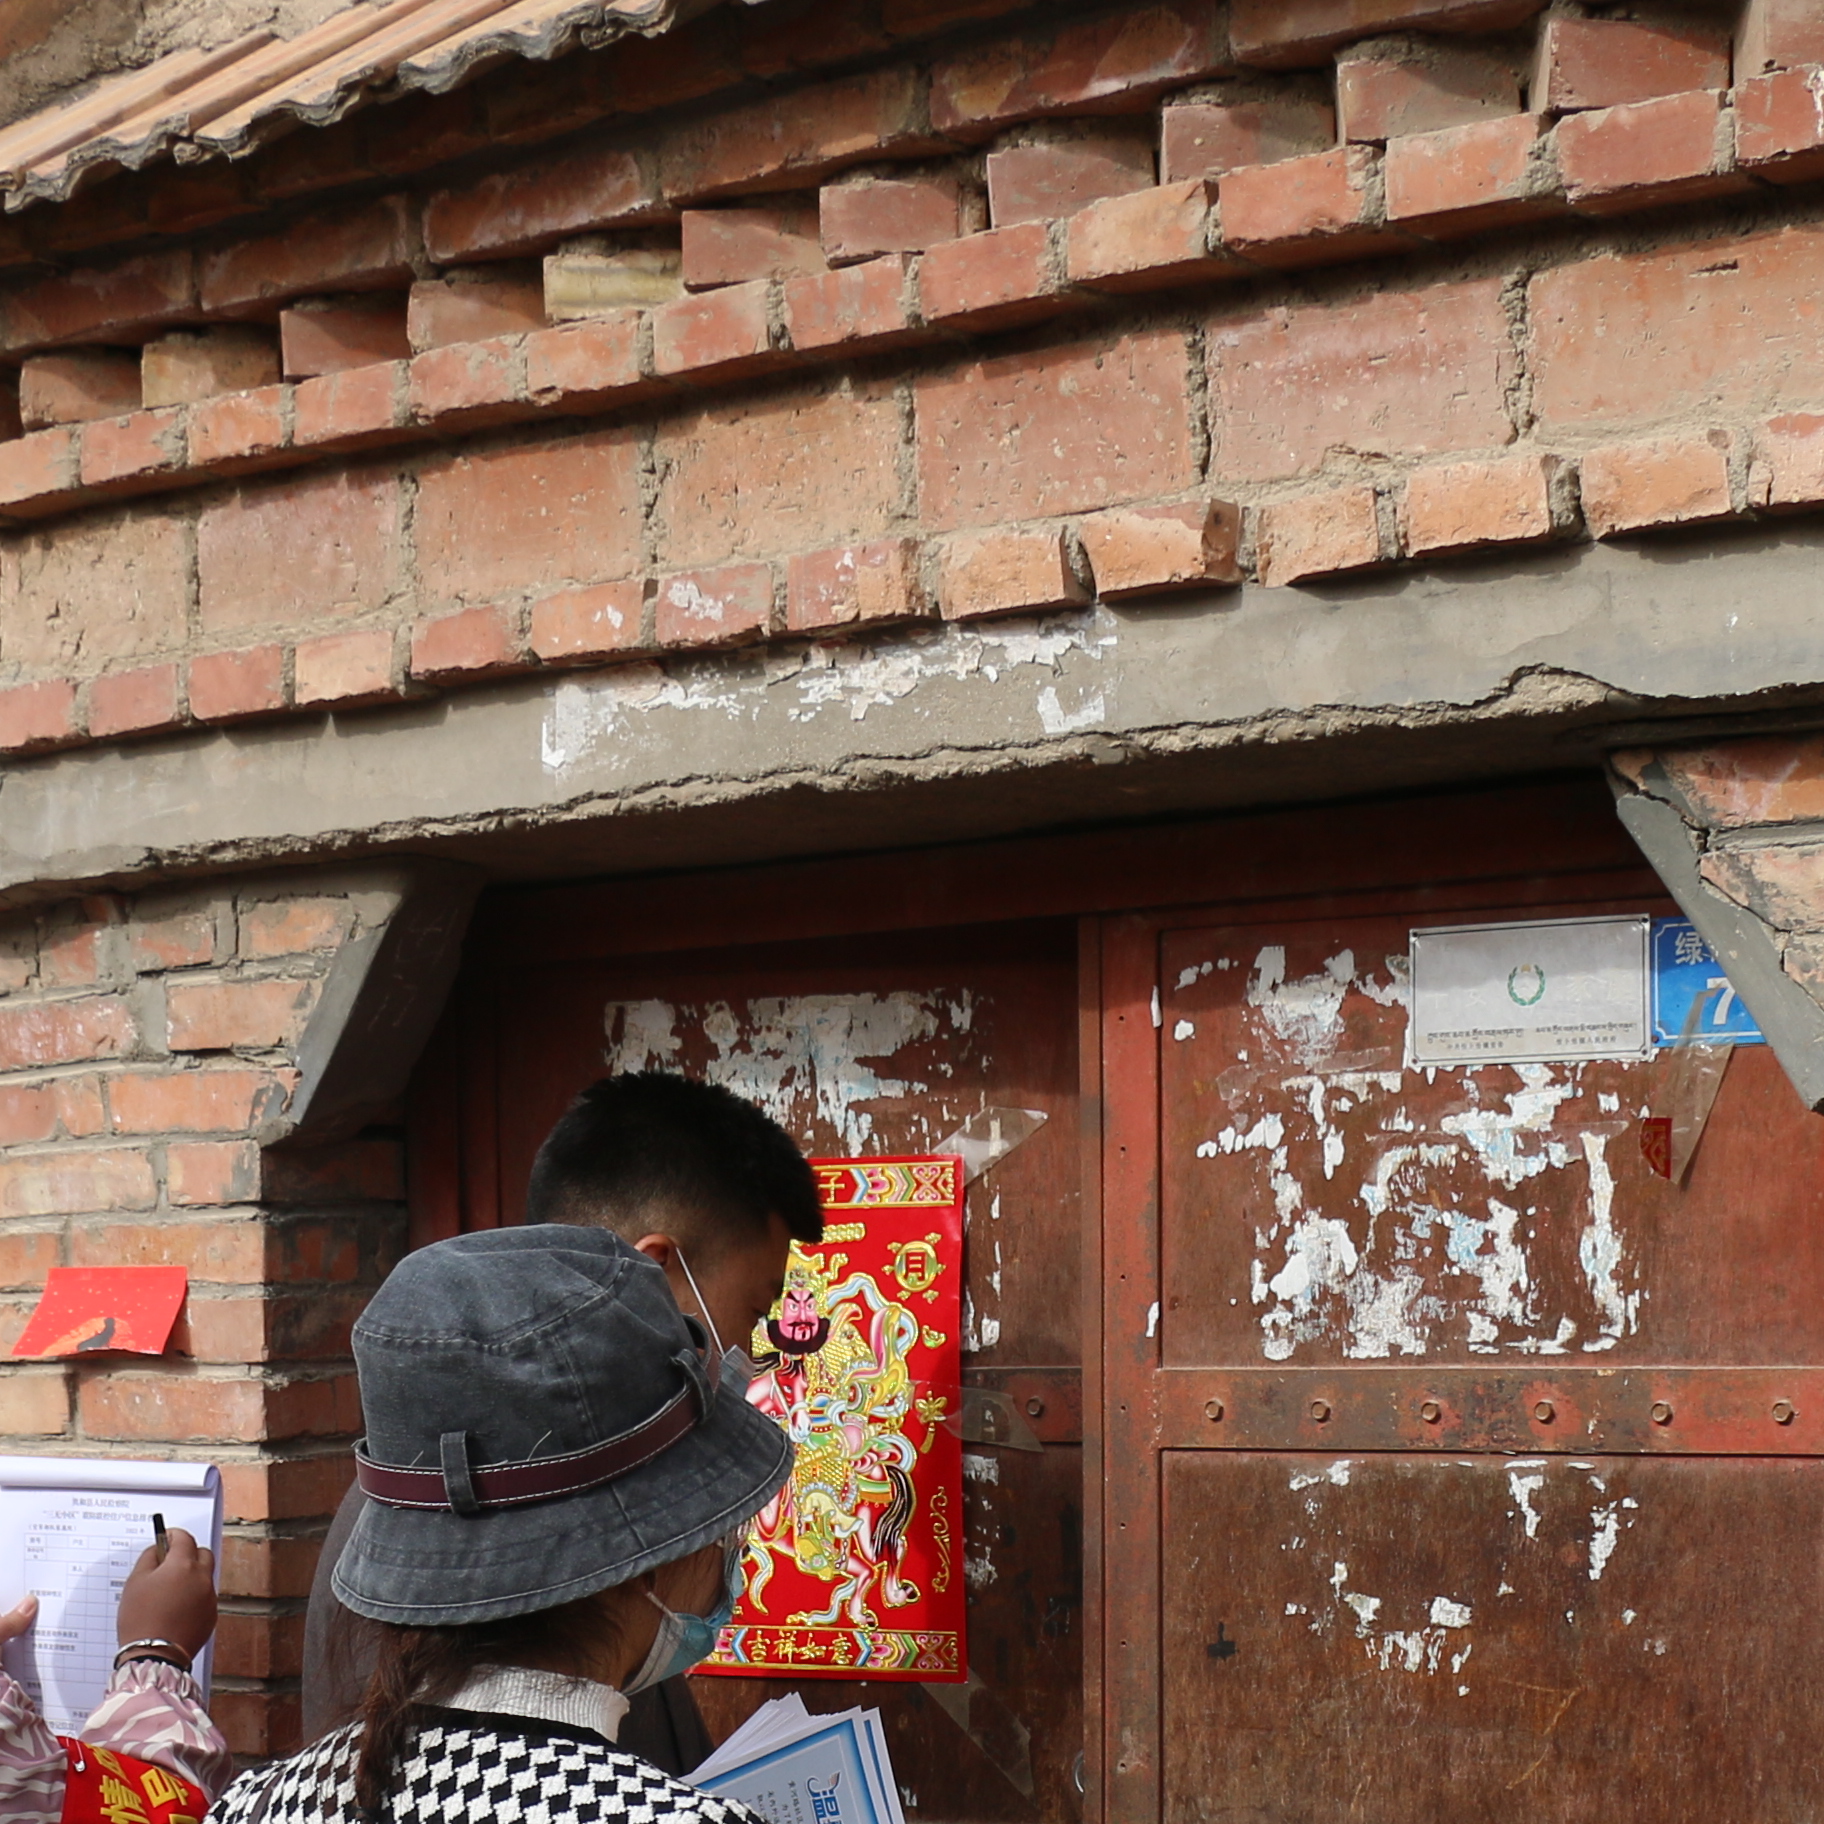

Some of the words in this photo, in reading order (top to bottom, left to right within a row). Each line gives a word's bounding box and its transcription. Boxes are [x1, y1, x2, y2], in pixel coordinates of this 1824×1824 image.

[1674, 931, 1716, 965] 绿
[747, 1629, 854, 1665] 吉祥如意
